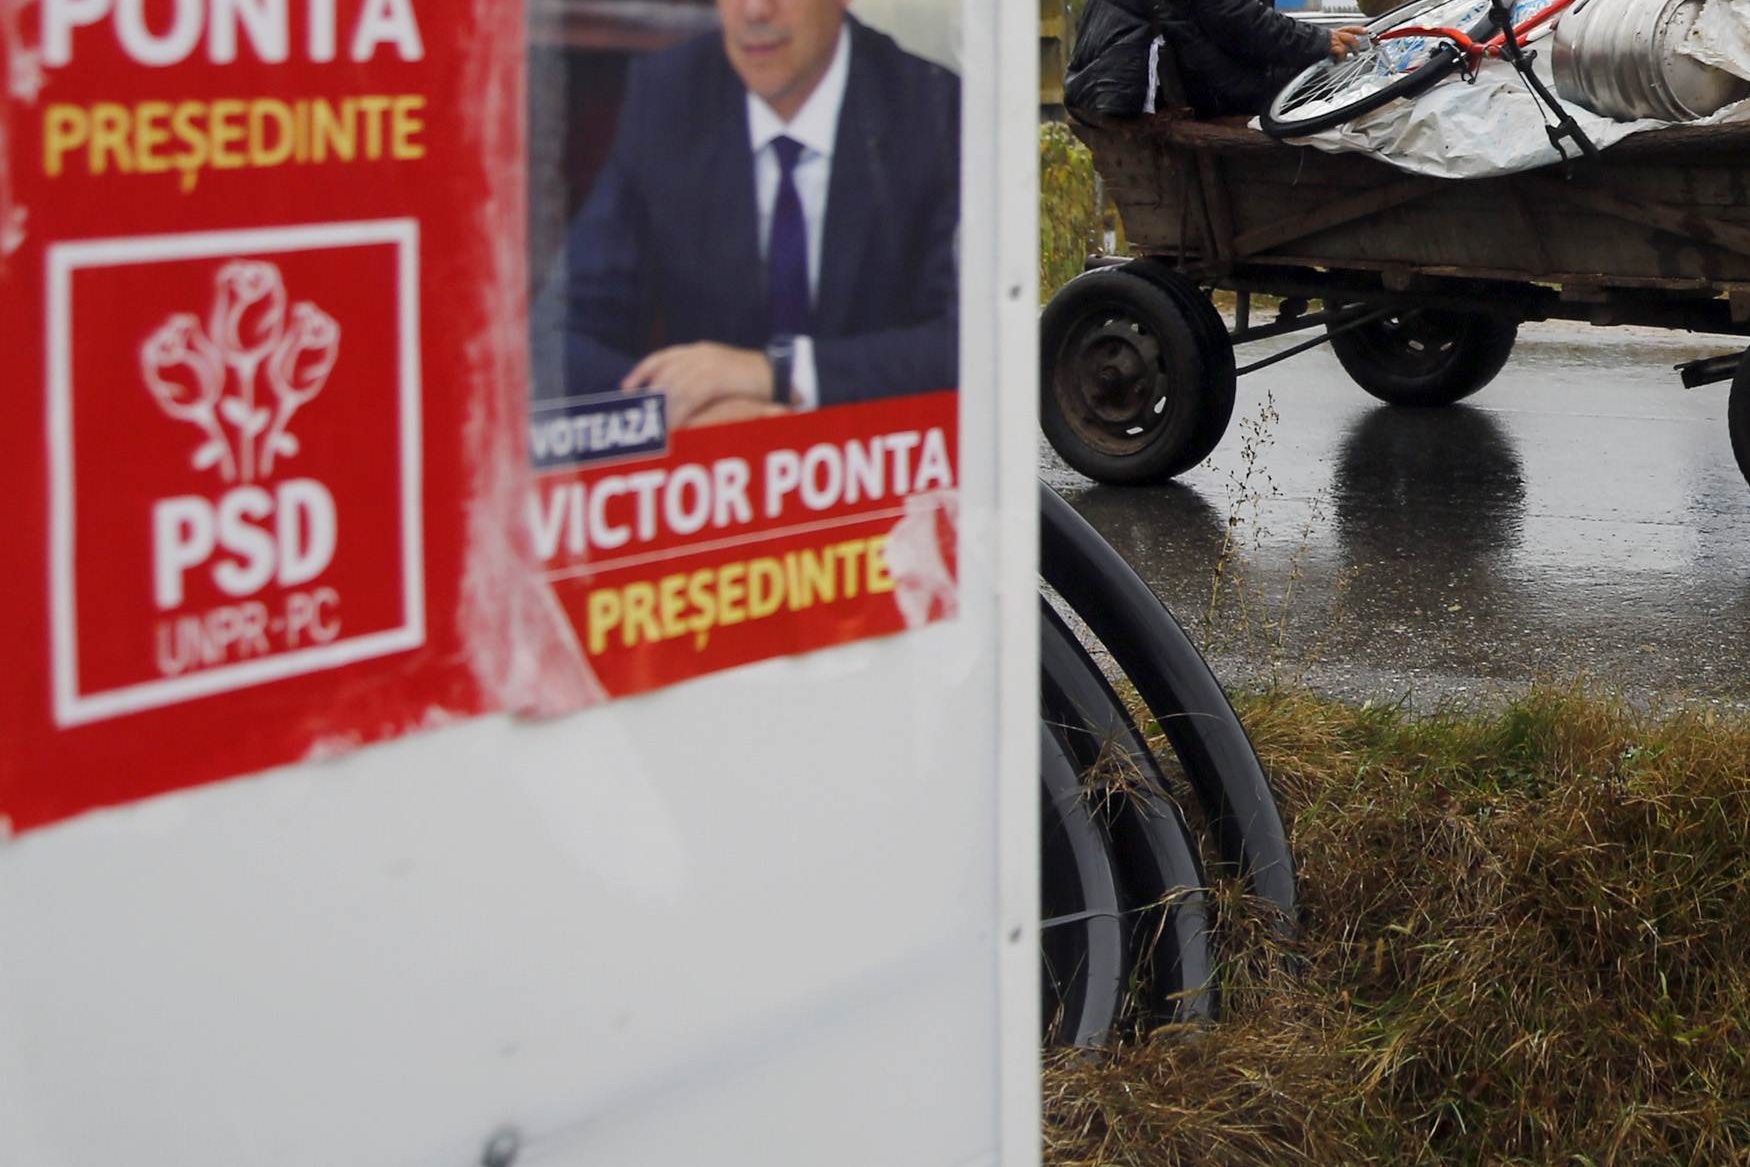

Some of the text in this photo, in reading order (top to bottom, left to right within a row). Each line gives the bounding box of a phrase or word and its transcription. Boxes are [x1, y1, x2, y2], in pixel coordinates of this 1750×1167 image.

[43, 94, 426, 193] PREȘEDINTE
[532, 398, 661, 460] VOTEAZĂ
[153, 478, 338, 610] PSD
[529, 427, 954, 561] VICTOR PONTA
